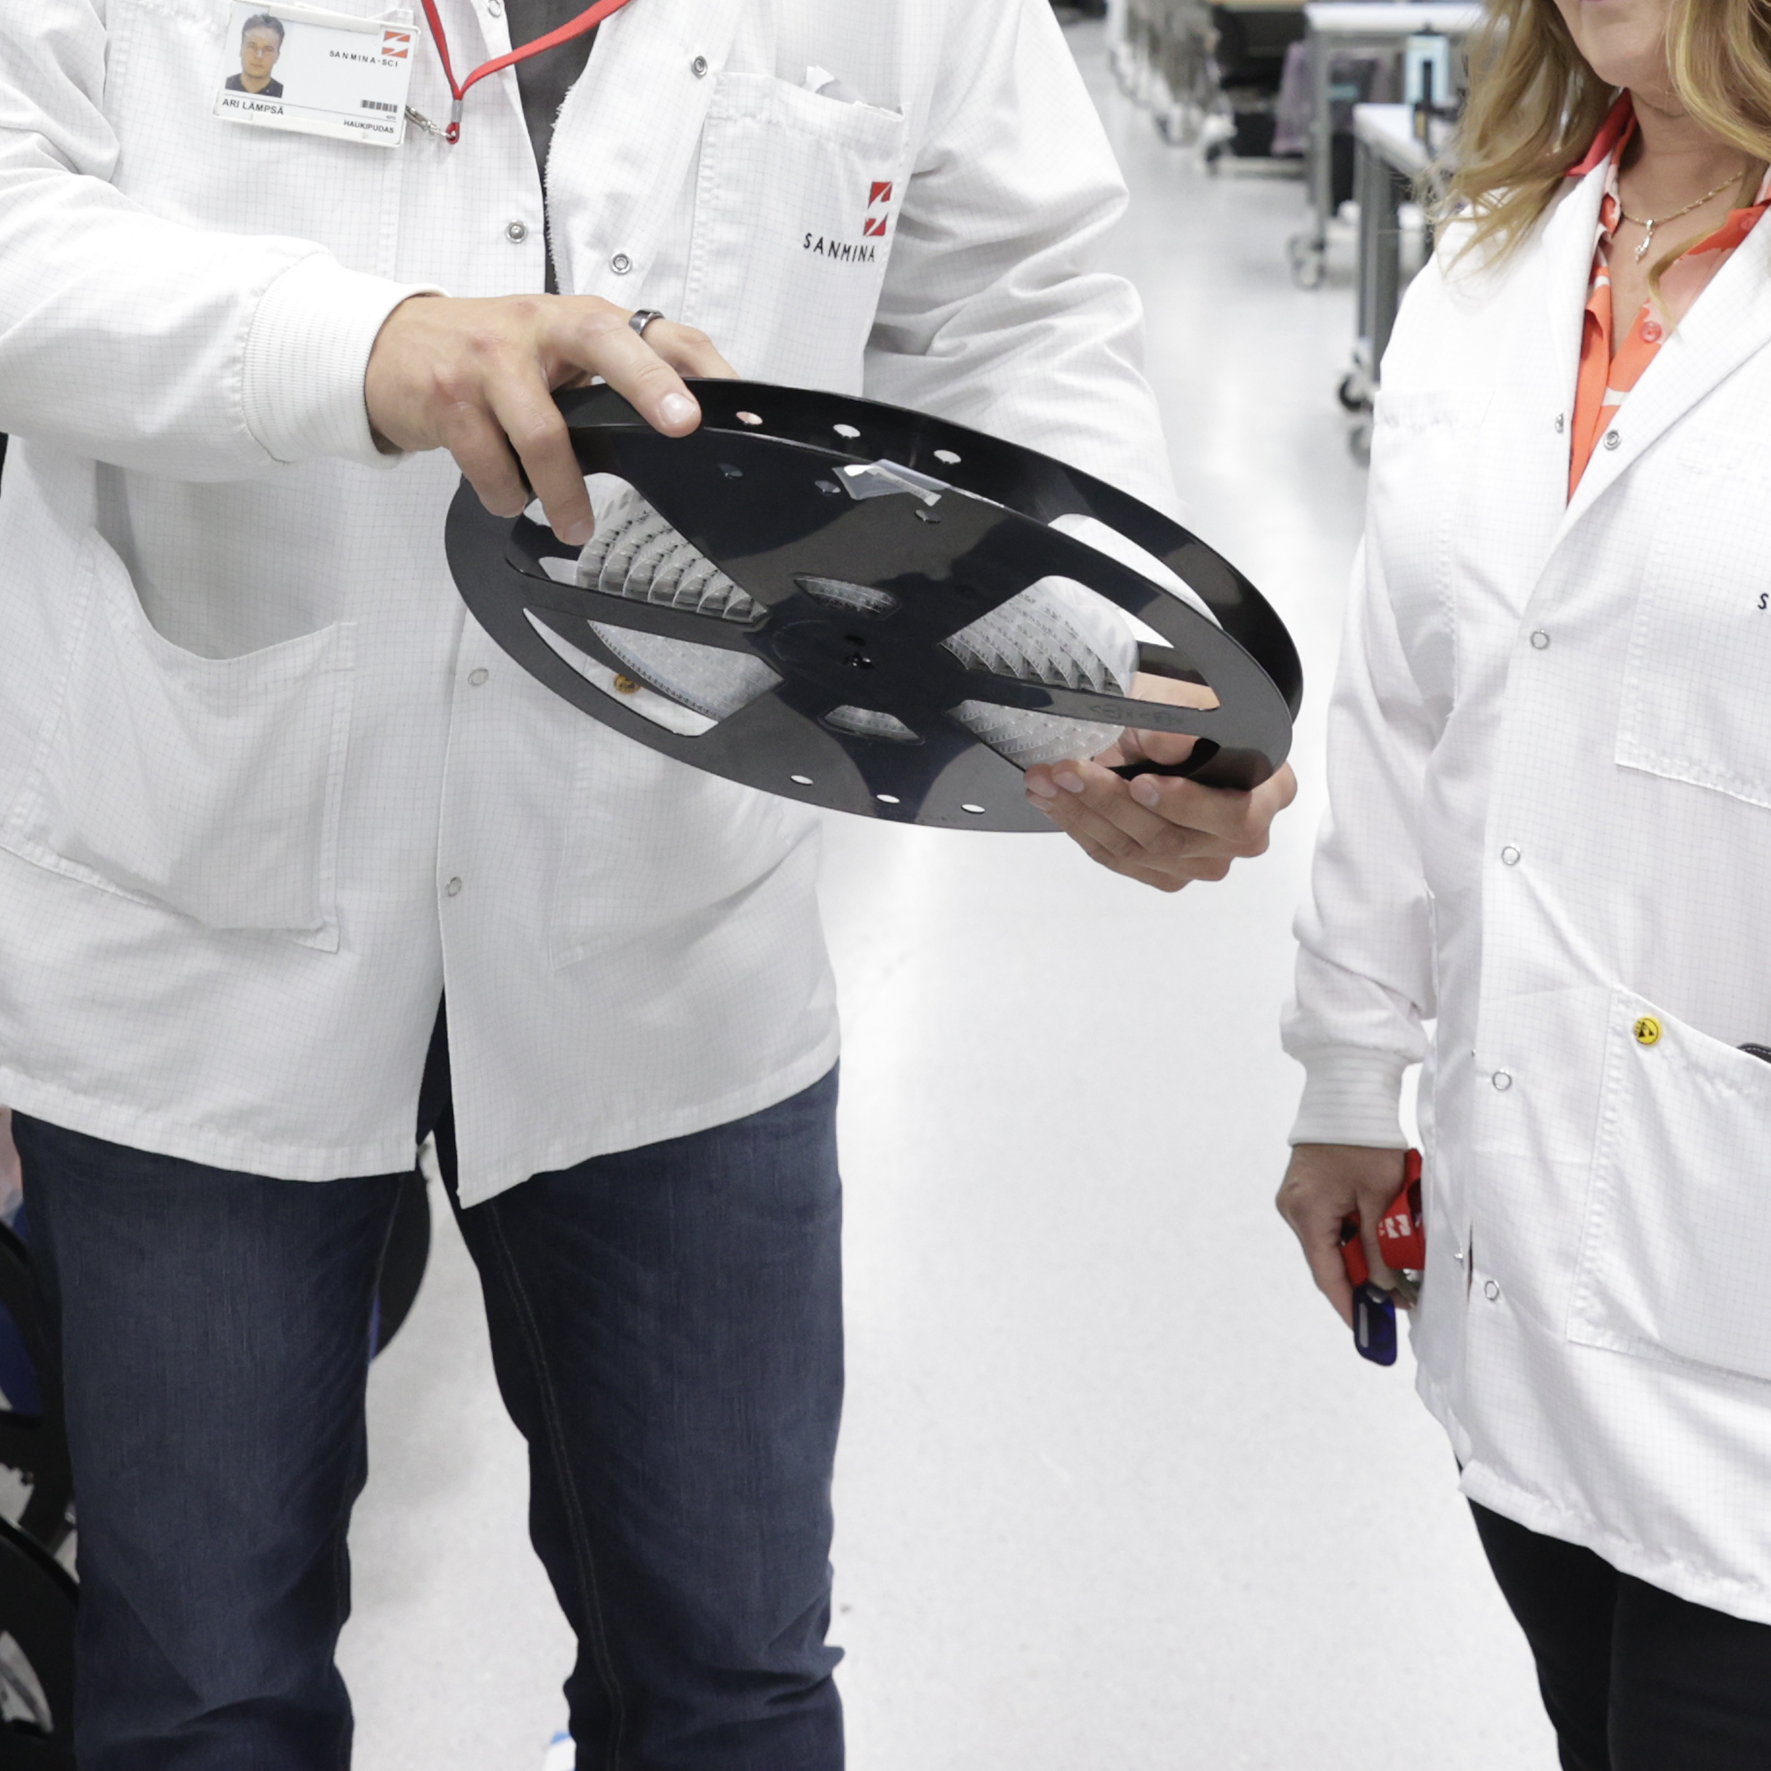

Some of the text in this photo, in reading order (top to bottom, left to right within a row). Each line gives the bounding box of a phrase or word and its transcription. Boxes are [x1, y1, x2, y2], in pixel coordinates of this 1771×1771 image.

[222, 98, 284, 116] ARI LÄMPSÄ
[343, 119, 395, 134] HAUKIPUDAS
[803, 232, 875, 263] SANMINA
